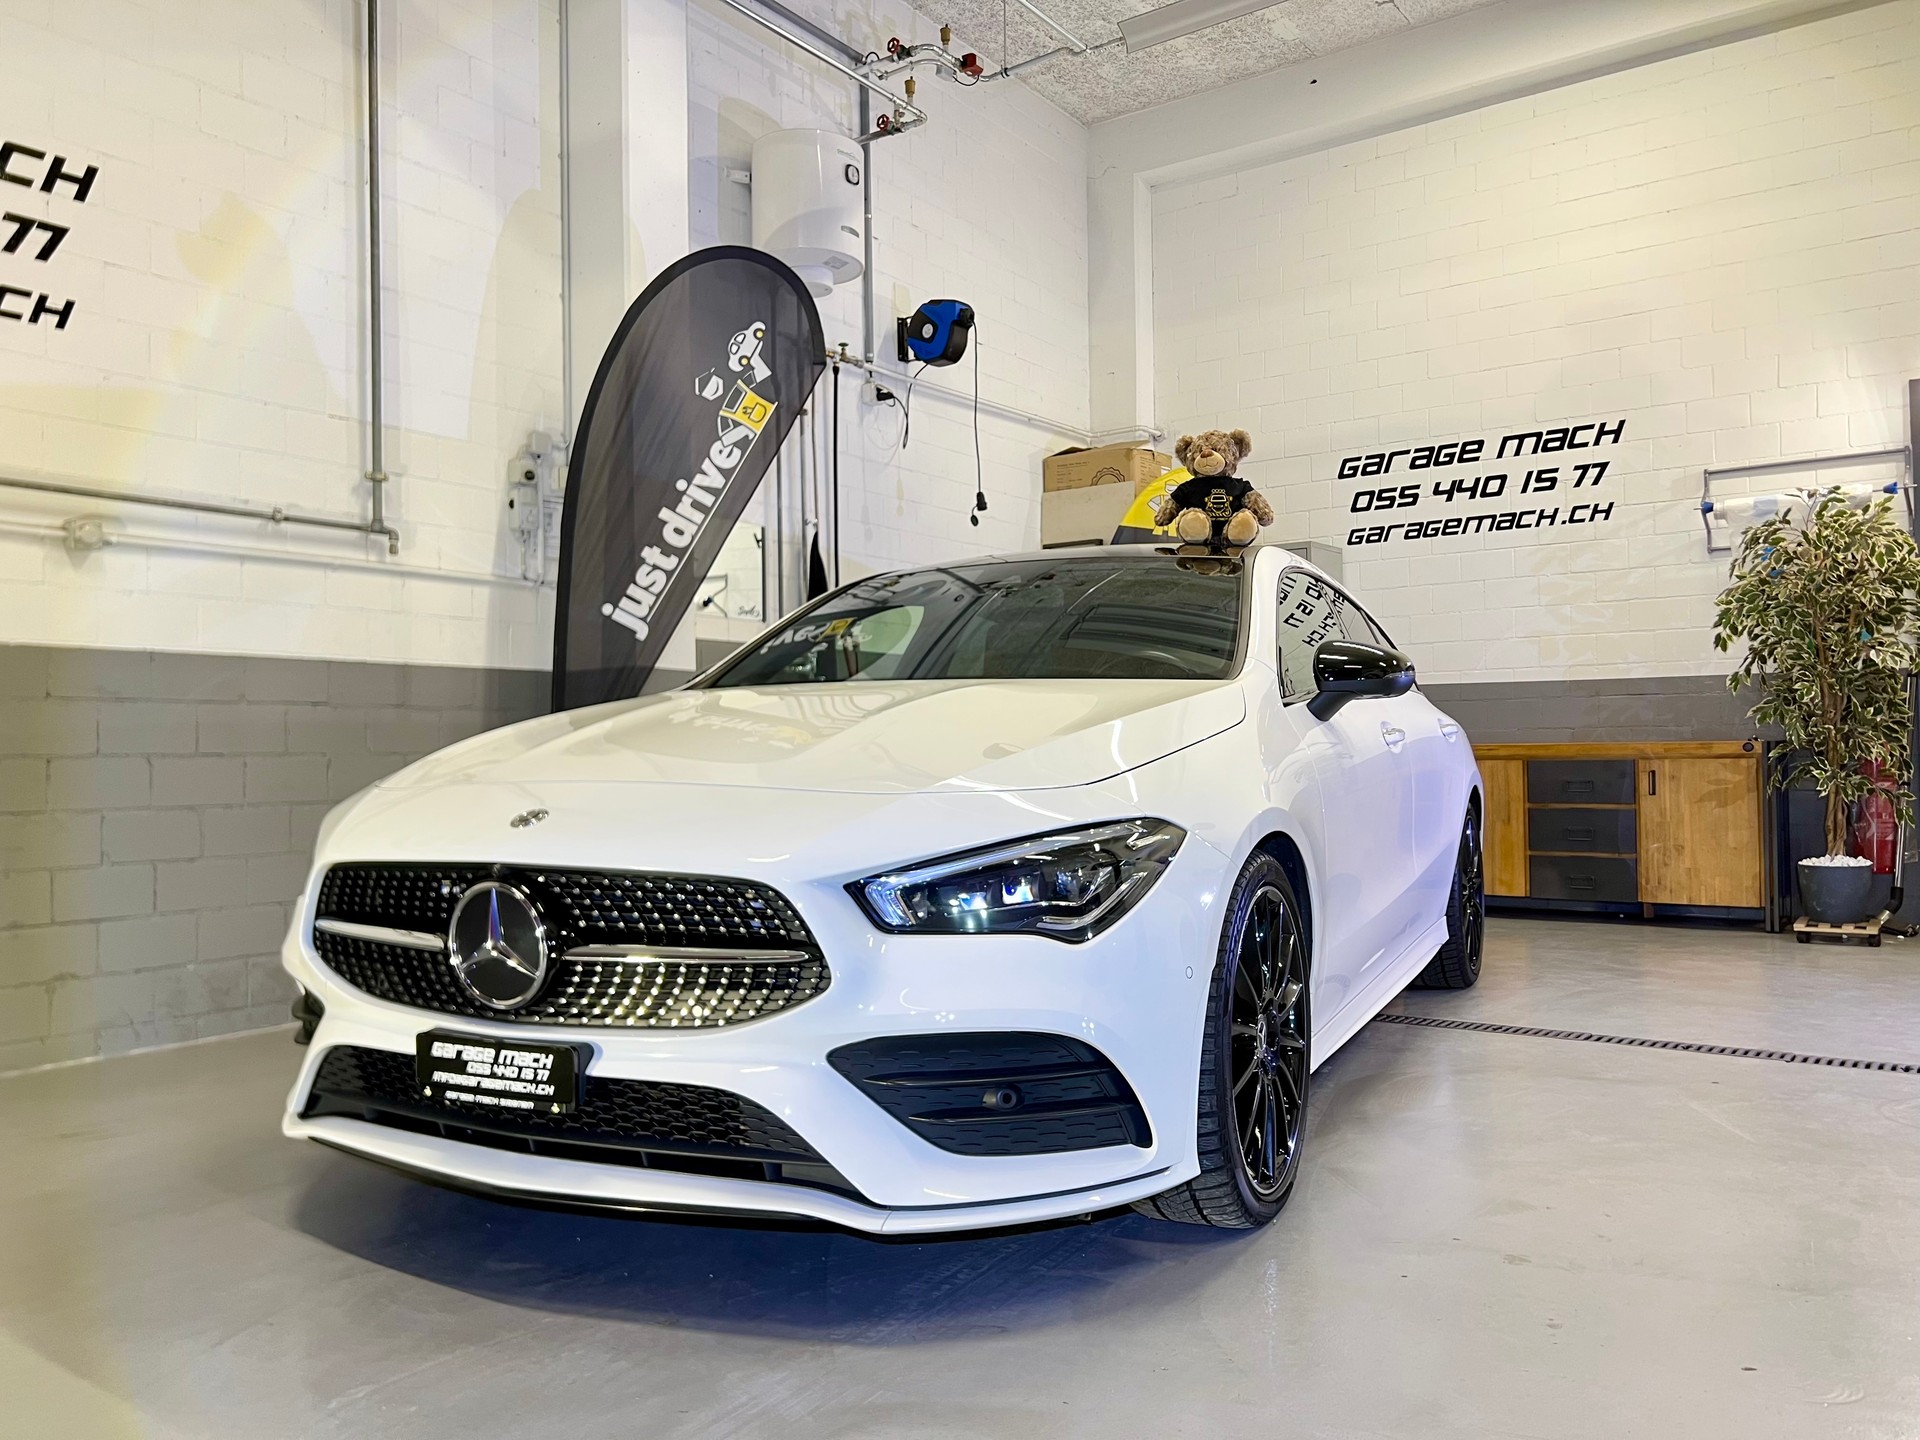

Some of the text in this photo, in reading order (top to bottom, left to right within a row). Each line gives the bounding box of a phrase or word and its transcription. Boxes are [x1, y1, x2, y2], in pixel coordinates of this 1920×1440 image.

[2, 211, 71, 263] 77
[1350, 484, 1421, 513] 055
[1432, 473, 1508, 502] 440
[1572, 461, 1611, 488] 77
[601, 544, 679, 642] just
